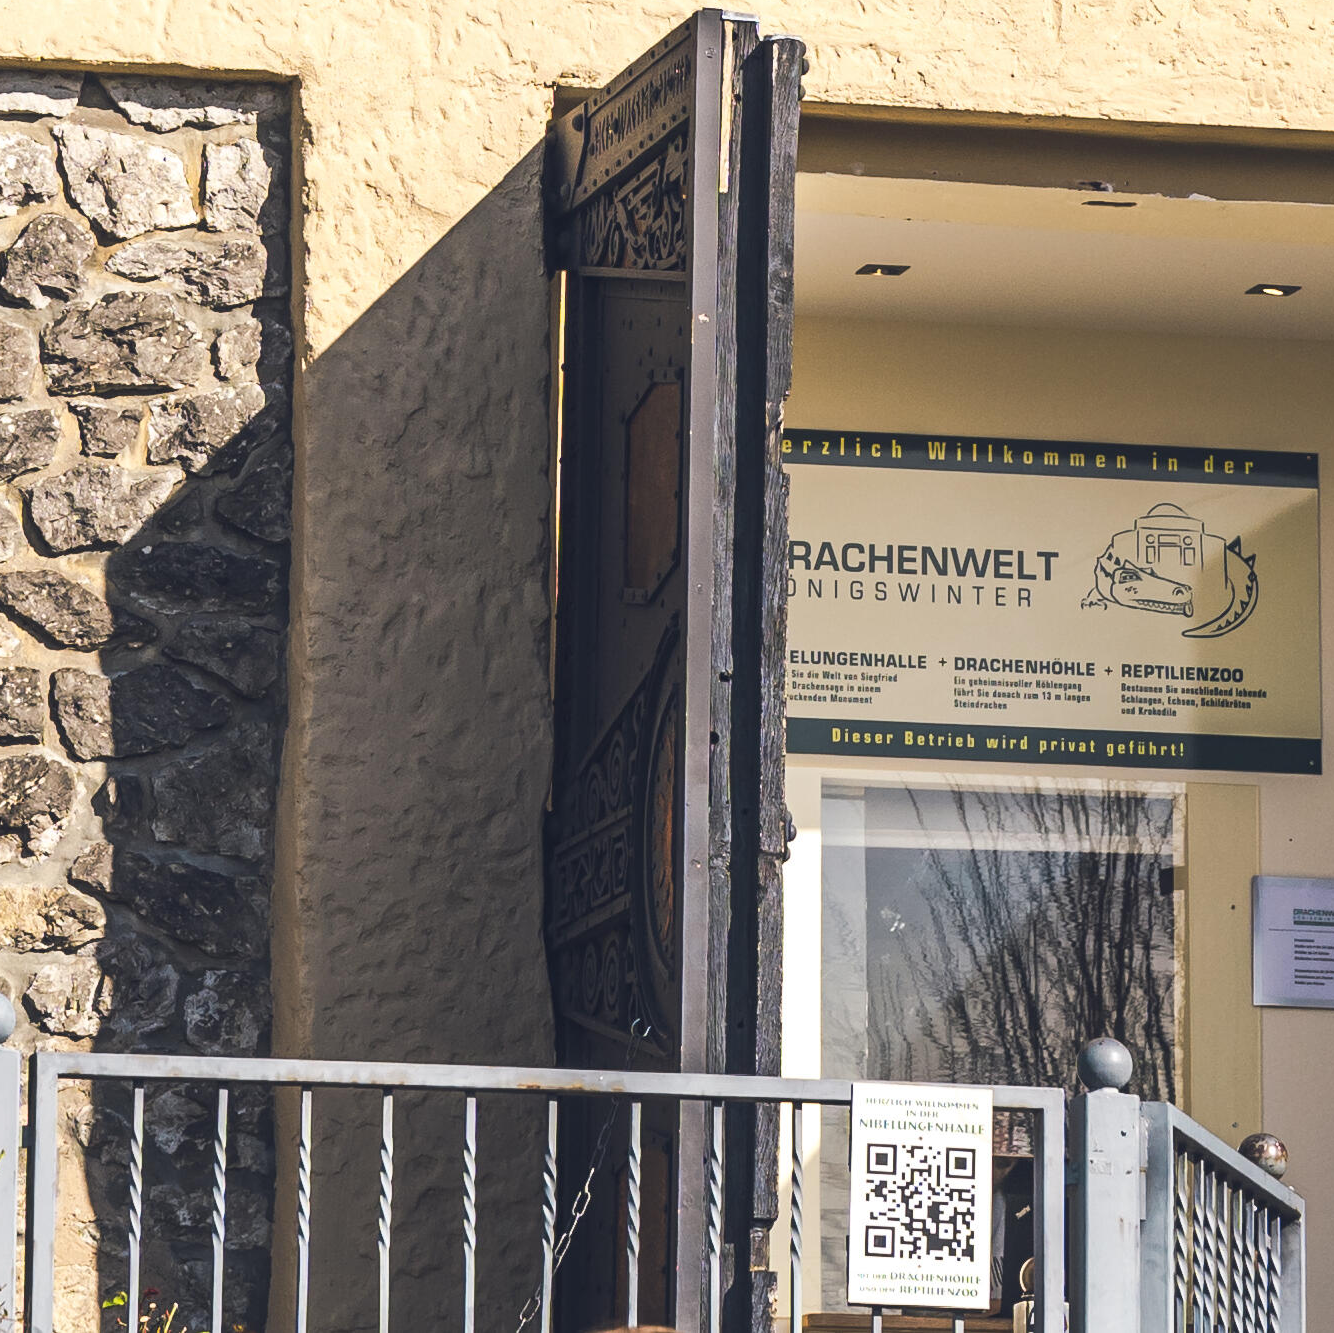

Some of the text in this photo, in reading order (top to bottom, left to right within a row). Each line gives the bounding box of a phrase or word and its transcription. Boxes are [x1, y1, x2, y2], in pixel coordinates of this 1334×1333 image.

[781, 437, 1253, 475] erzlich Willkommen in der
[787, 540, 1060, 581] RACHENWELT
[787, 574, 1032, 608] ÖNIGSWINTER
[789, 650, 927, 669] ELUNGENHALLE
[954, 657, 1096, 677] DRACHENHÖHLE
[1121, 664, 1244, 683] REPTILIENZOO
[791, 670, 804, 678] Sie
[822, 671, 841, 680] Welt
[861, 673, 898, 684] Siegfried
[792, 681, 844, 693] Drachensage
[831, 727, 1185, 757] Dieser Betrieb wird privat geführt!
[859, 1118, 984, 1134] NIBELUNGENHALLE
